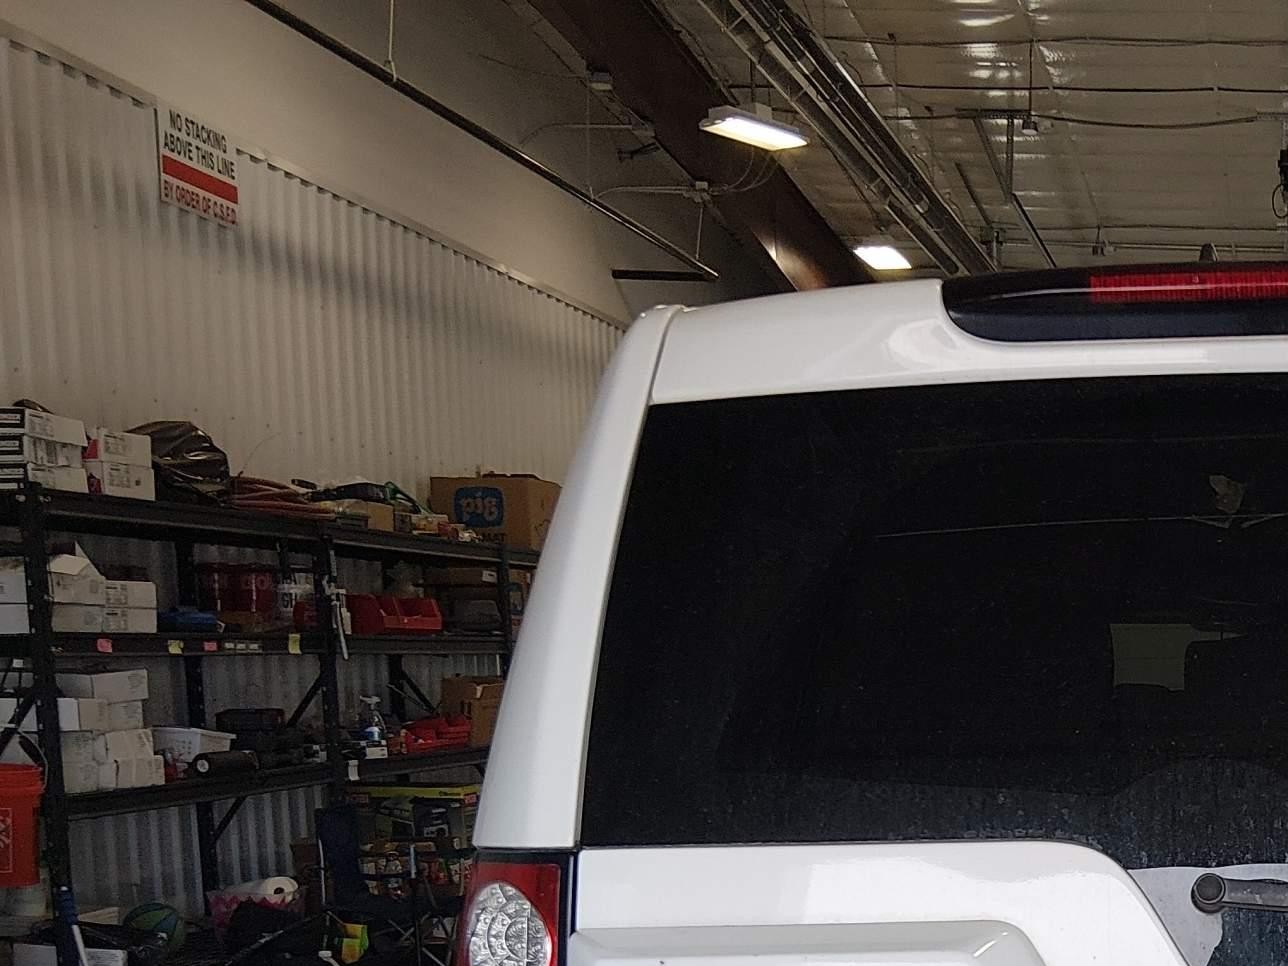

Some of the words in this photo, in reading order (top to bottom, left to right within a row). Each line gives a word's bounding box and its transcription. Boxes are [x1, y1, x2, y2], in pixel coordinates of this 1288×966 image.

[169, 109, 182, 133] NO
[184, 117, 227, 154] STACKING
[163, 130, 193, 162] ABOVE
[195, 145, 215, 171] THIS
[216, 155, 236, 181] LINE
[163, 180, 174, 200] BY
[175, 184, 200, 210] ORDER
[201, 196, 212, 214] OF
